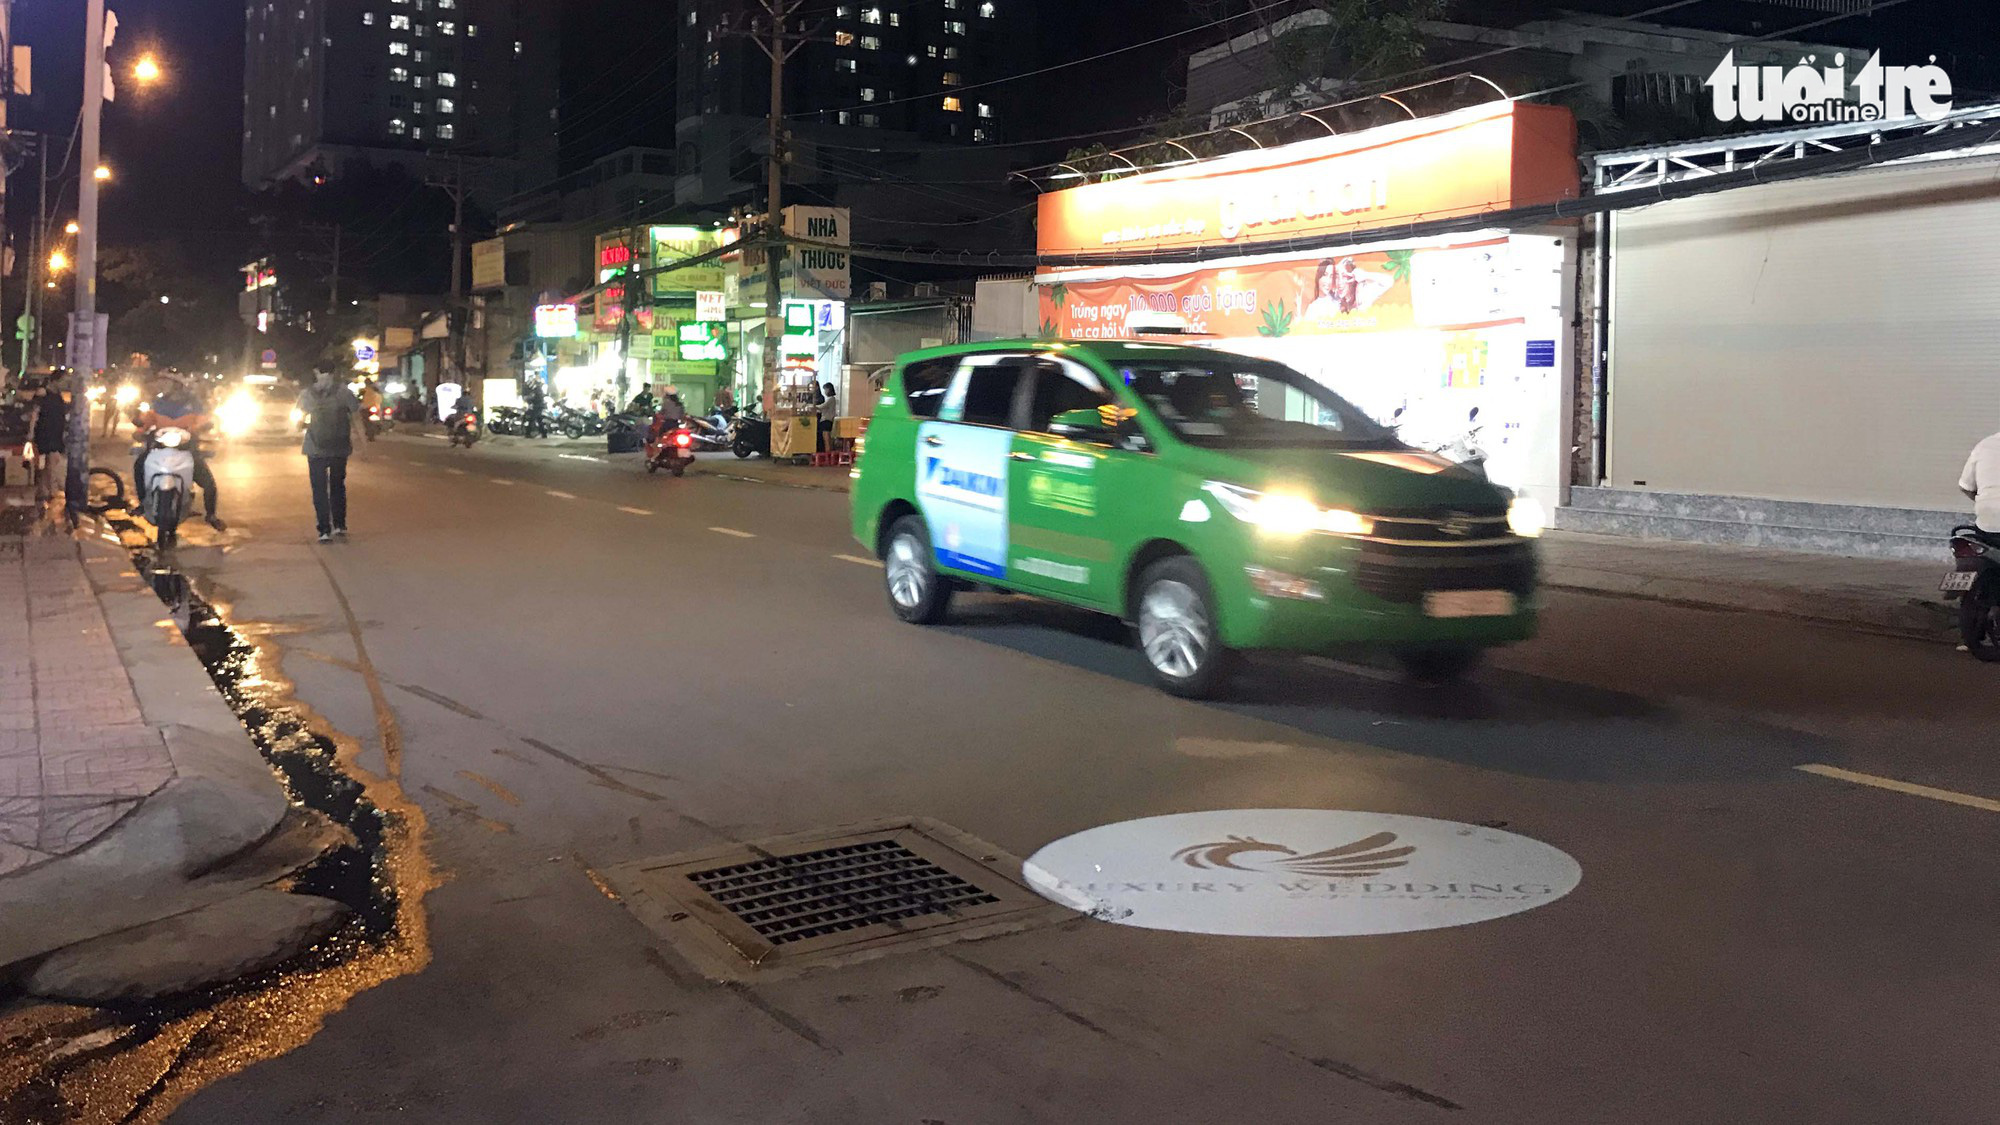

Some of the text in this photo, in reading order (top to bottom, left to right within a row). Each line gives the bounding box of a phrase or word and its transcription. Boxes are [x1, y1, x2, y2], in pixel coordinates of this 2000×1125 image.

[807, 214, 838, 237] NHÀ
[1071, 301, 1098, 322] Trúng
[1101, 303, 1127, 321] ngay
[1182, 285, 1212, 318] quà
[1216, 284, 1257, 316] tặng
[1071, 322, 1083, 338] và
[1279, 880, 1551, 895] WEDDING
